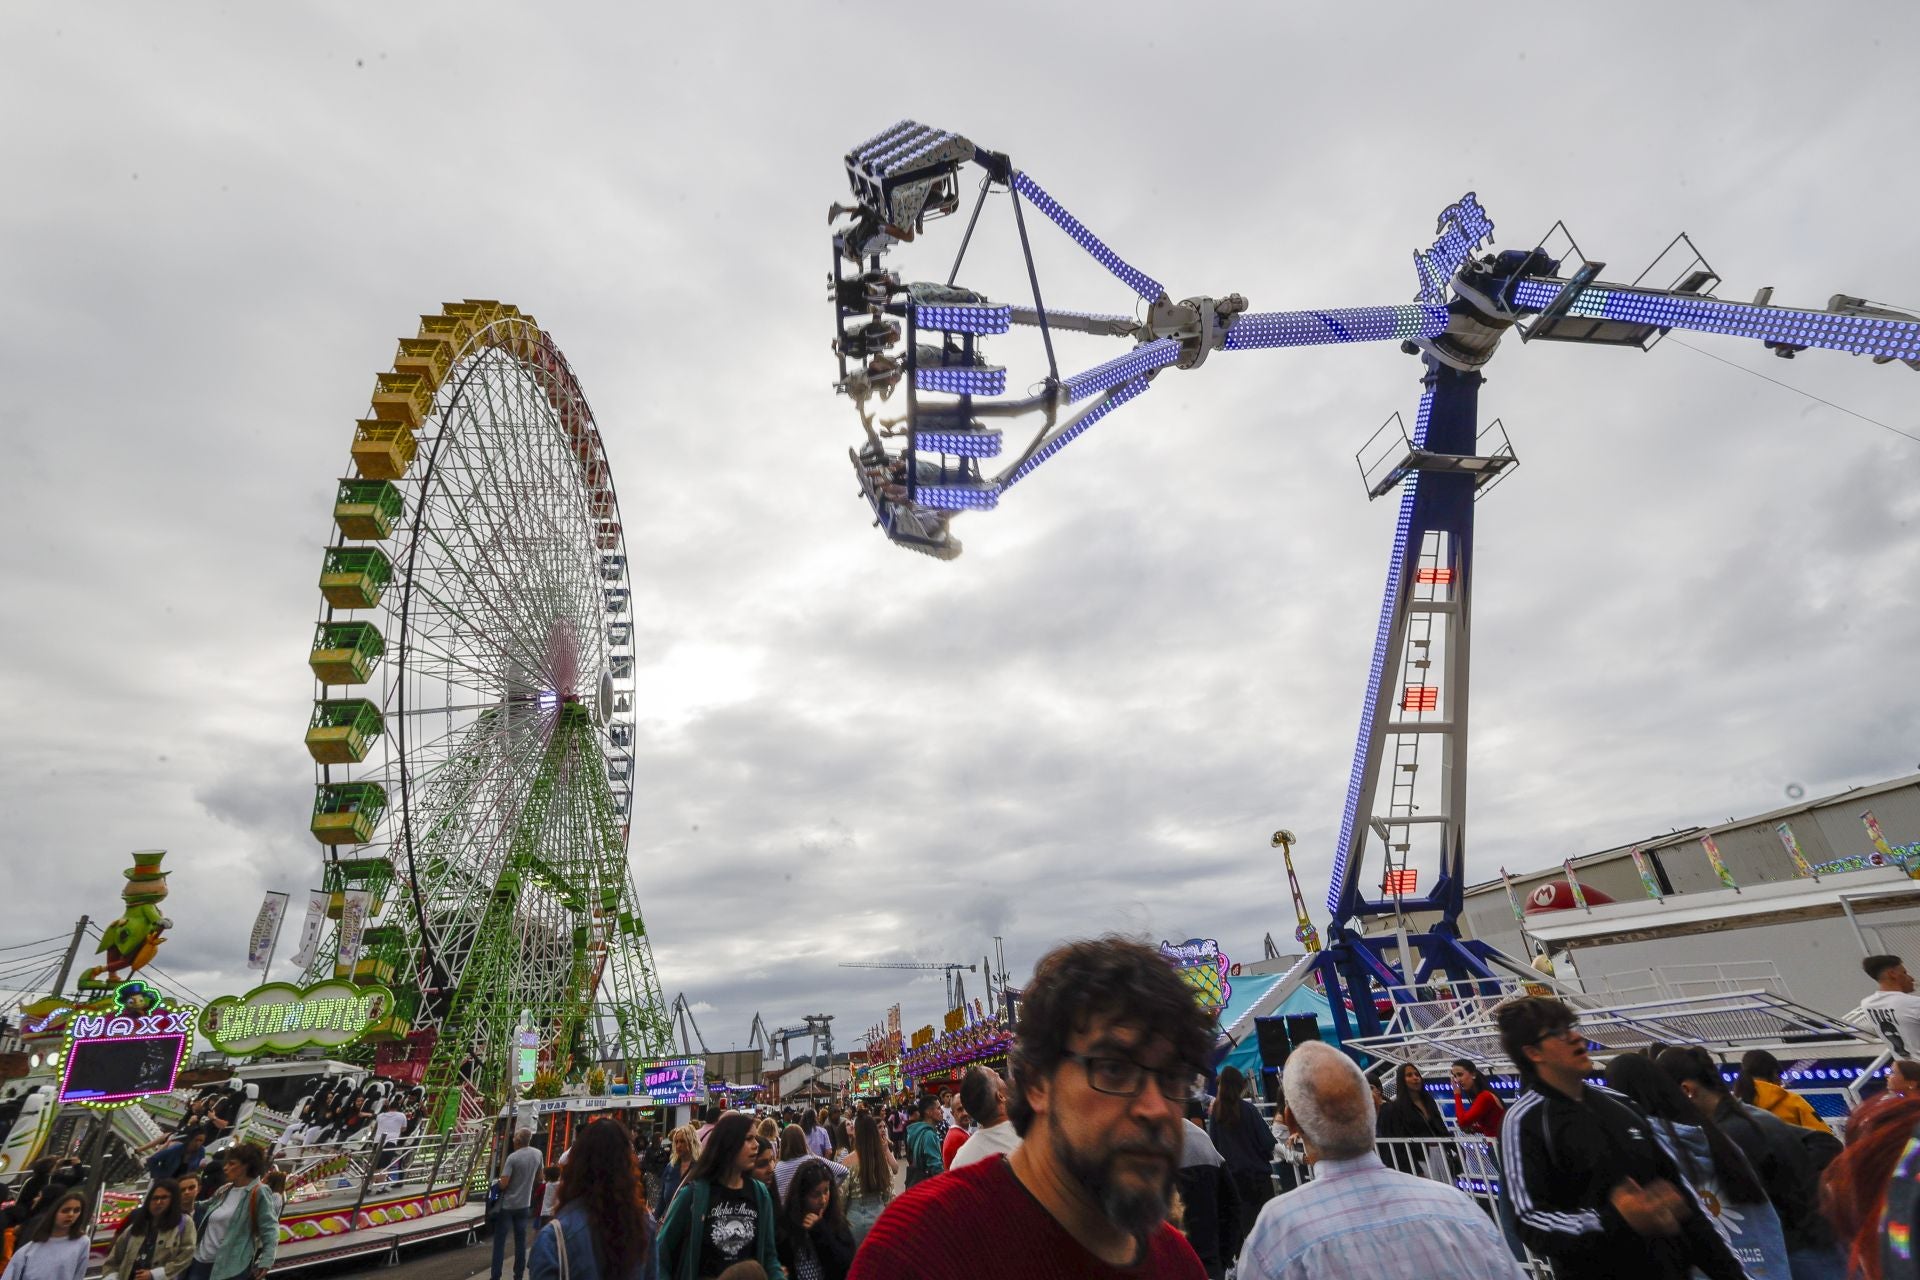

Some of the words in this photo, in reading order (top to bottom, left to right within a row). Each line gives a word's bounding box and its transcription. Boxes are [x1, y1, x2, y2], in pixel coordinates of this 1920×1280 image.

[1535, 886, 1553, 902] M
[74, 1011, 192, 1038] MAXX
[216, 996, 370, 1043] SALTAMONTES
[1867, 1008, 1900, 1026] TRUST
[647, 1087, 678, 1097] AQUILLA
